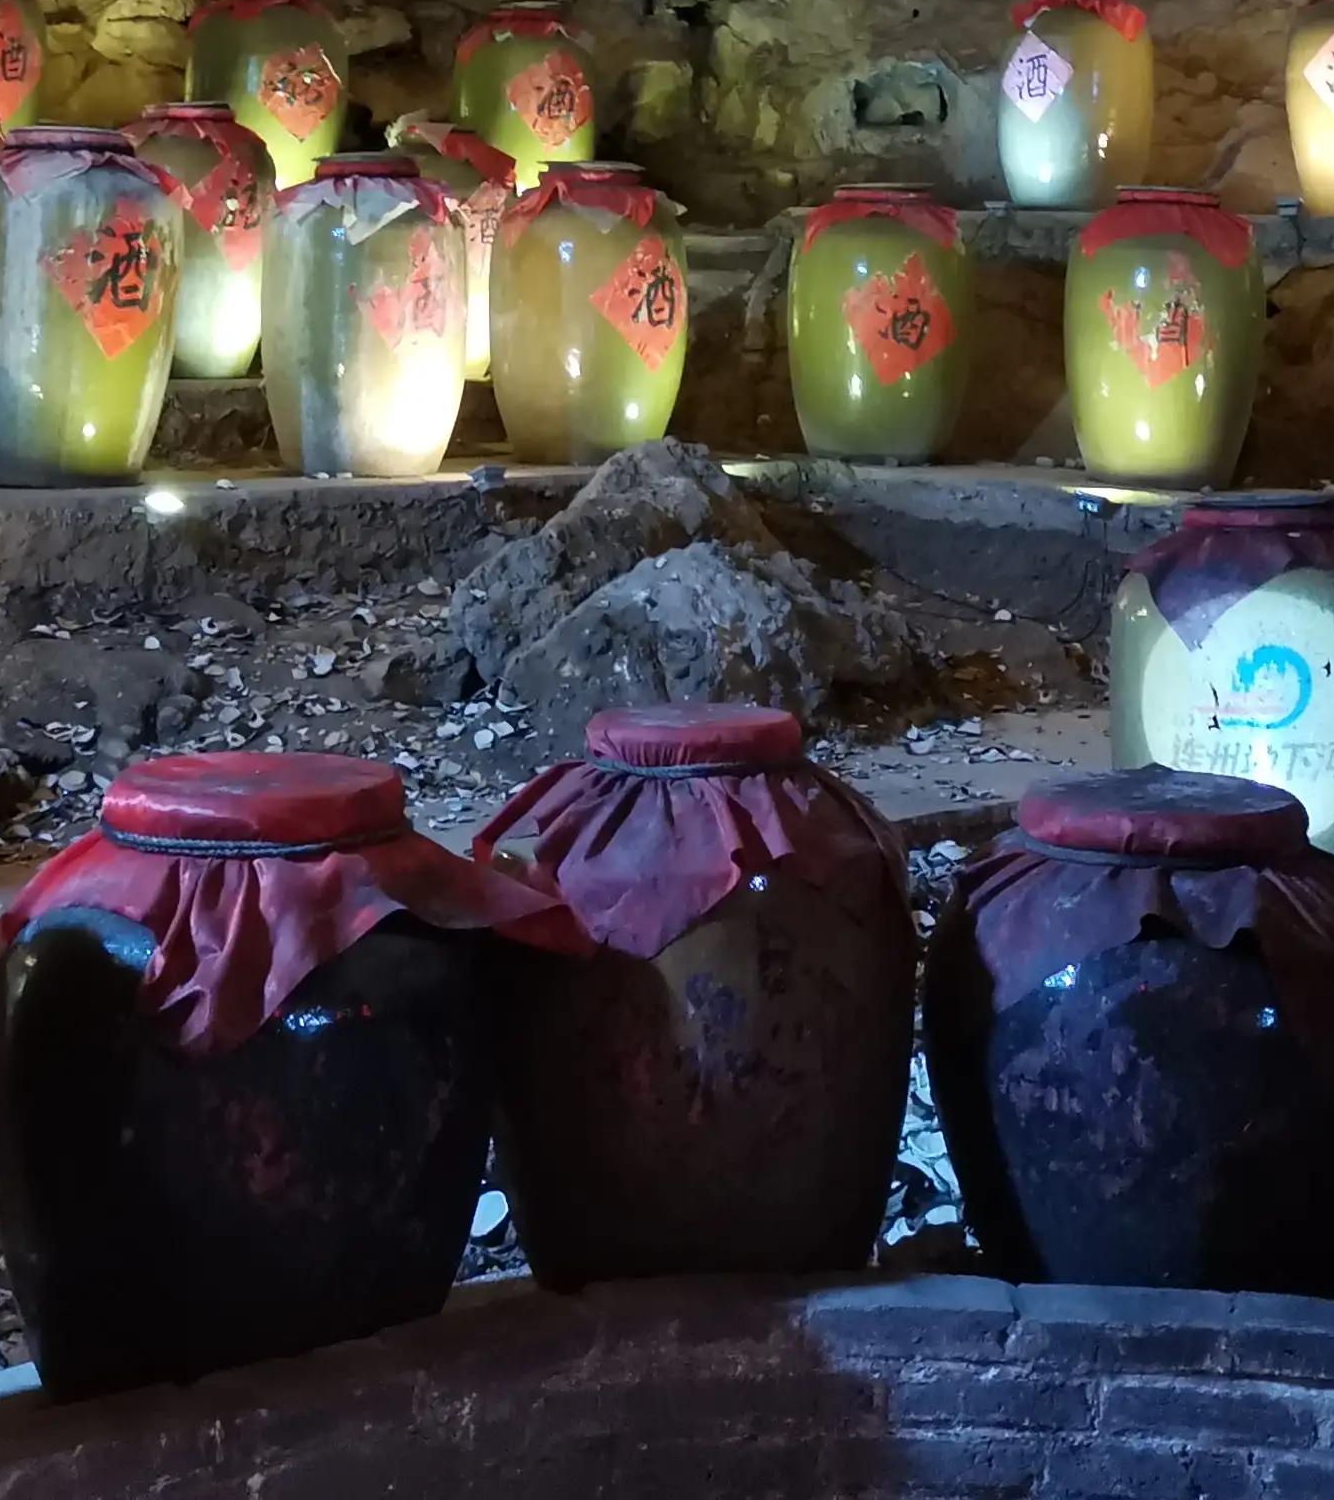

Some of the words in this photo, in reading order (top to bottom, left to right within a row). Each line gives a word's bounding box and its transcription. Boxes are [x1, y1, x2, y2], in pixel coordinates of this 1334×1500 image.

[1017, 53, 1050, 100] 酒
[85, 226, 157, 311] 酒
[629, 264, 676, 329] 酒
